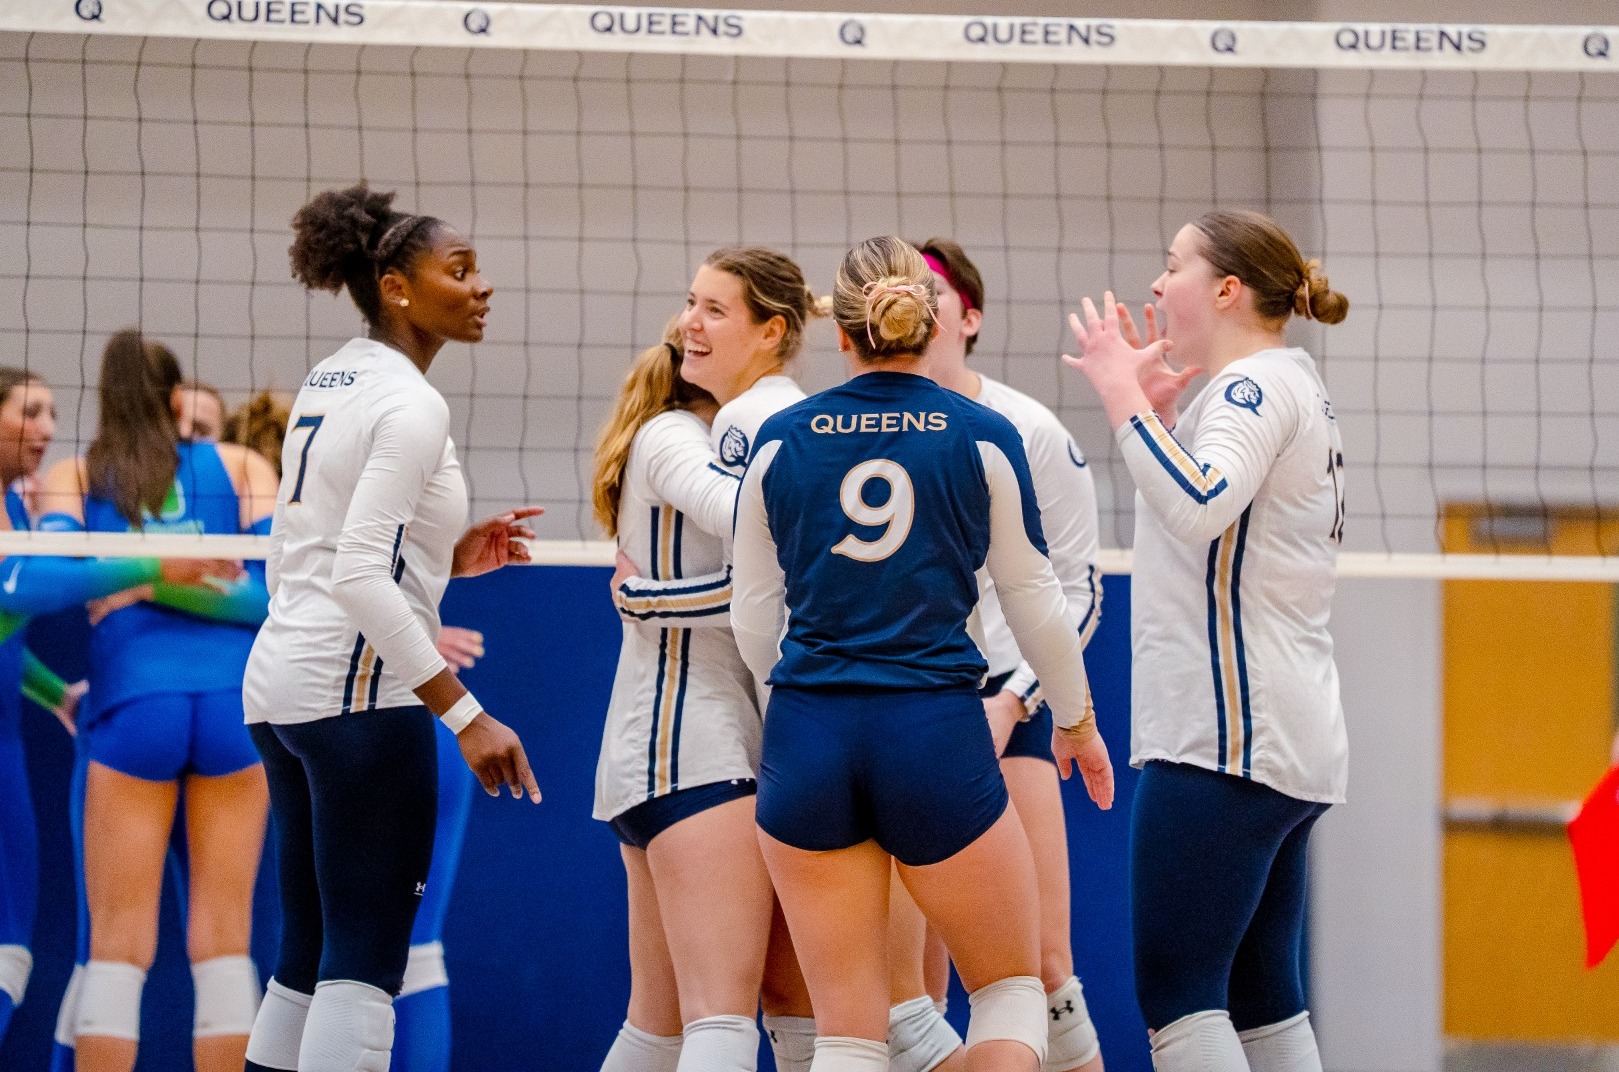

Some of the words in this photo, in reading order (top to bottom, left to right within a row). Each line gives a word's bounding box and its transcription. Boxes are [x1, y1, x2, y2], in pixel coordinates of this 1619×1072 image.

[74, 0, 103, 22] Q
[206, 0, 366, 27] QUEENS
[462, 10, 491, 36] Q
[590, 10, 744, 38] QUEENS
[839, 20, 866, 47] Q
[963, 21, 1117, 47] QUEENS
[1210, 28, 1237, 54] Q
[1334, 27, 1488, 53] QUEENS
[1582, 33, 1610, 58] Q
[304, 370, 358, 388] UEENS
[810, 411, 949, 434] QUEENS
[288, 411, 327, 506] 7
[831, 458, 915, 563] 9
